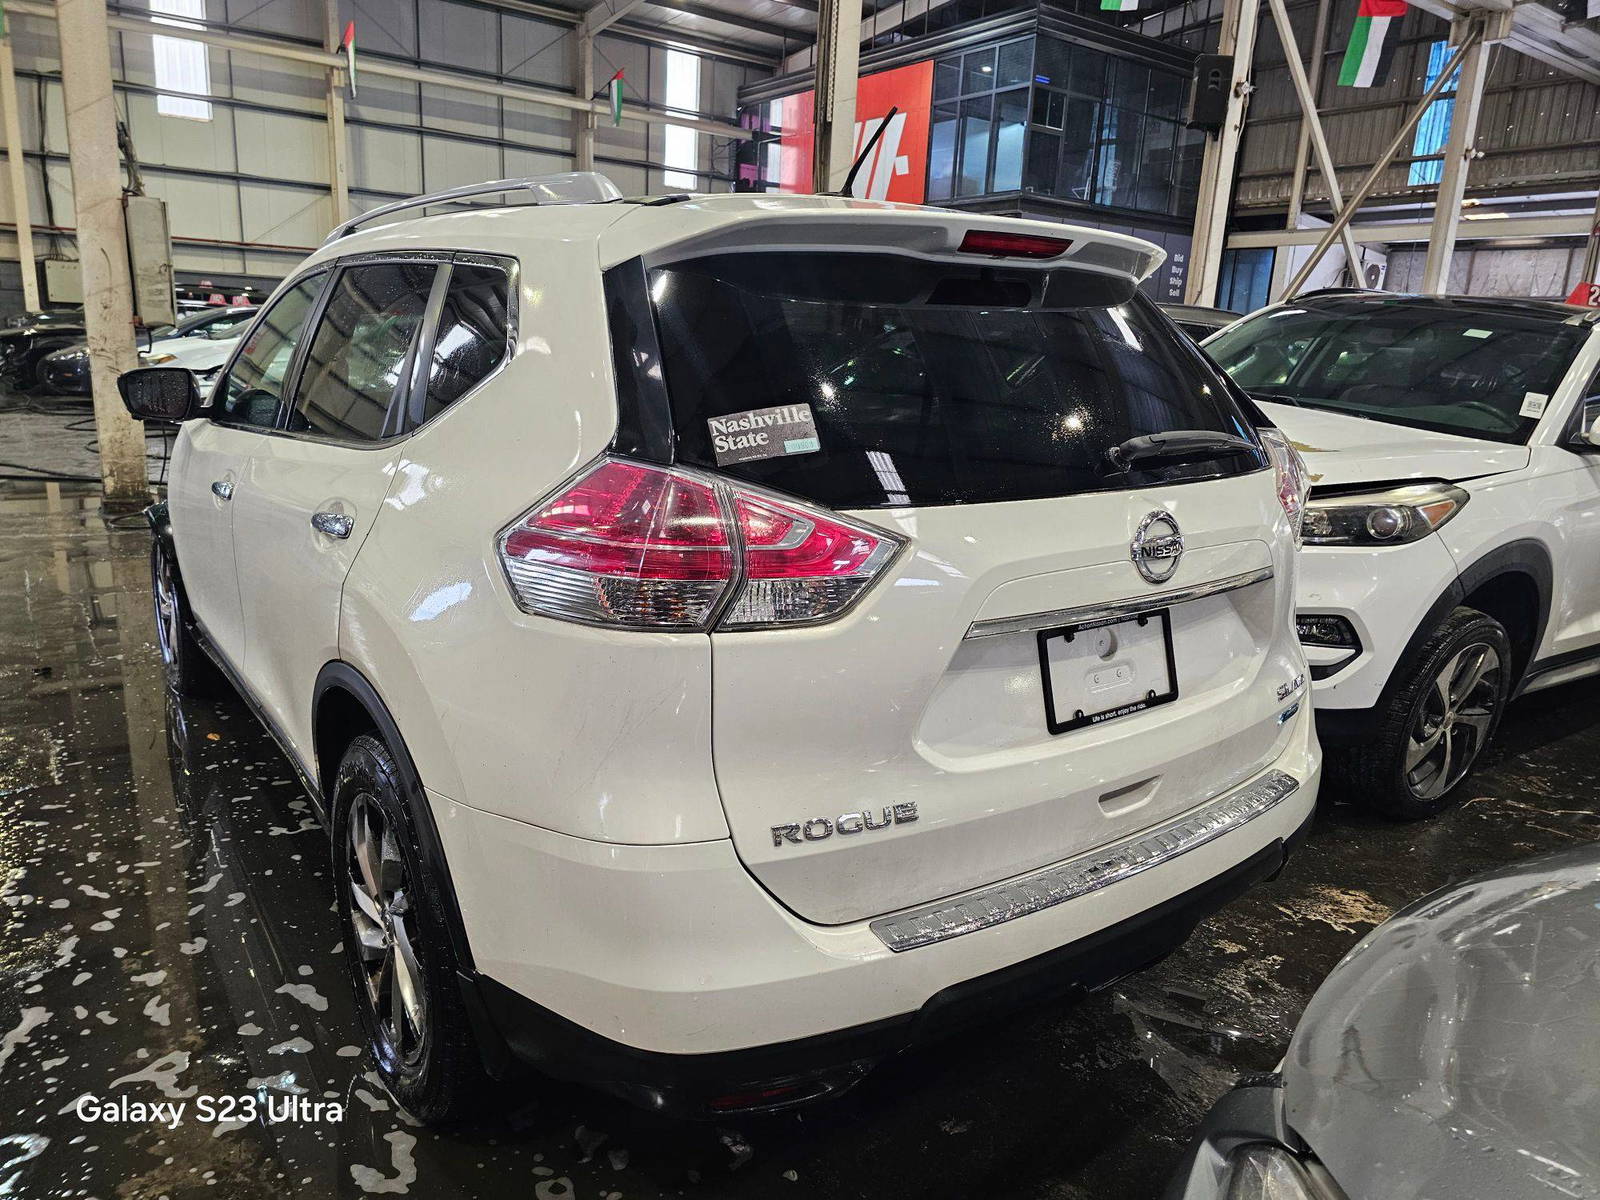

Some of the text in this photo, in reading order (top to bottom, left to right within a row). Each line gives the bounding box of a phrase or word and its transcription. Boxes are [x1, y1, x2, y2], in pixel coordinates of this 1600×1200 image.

[1174, 253, 1184, 263] Bid
[1171, 265, 1183, 276] Buy
[1169, 277, 1182, 287] Ship
[1169, 288, 1180, 297] Sell
[1587, 285, 1600, 307] 2
[709, 406, 813, 437] Nashville
[714, 431, 770, 454] State
[770, 801, 920, 847] ROGUE
